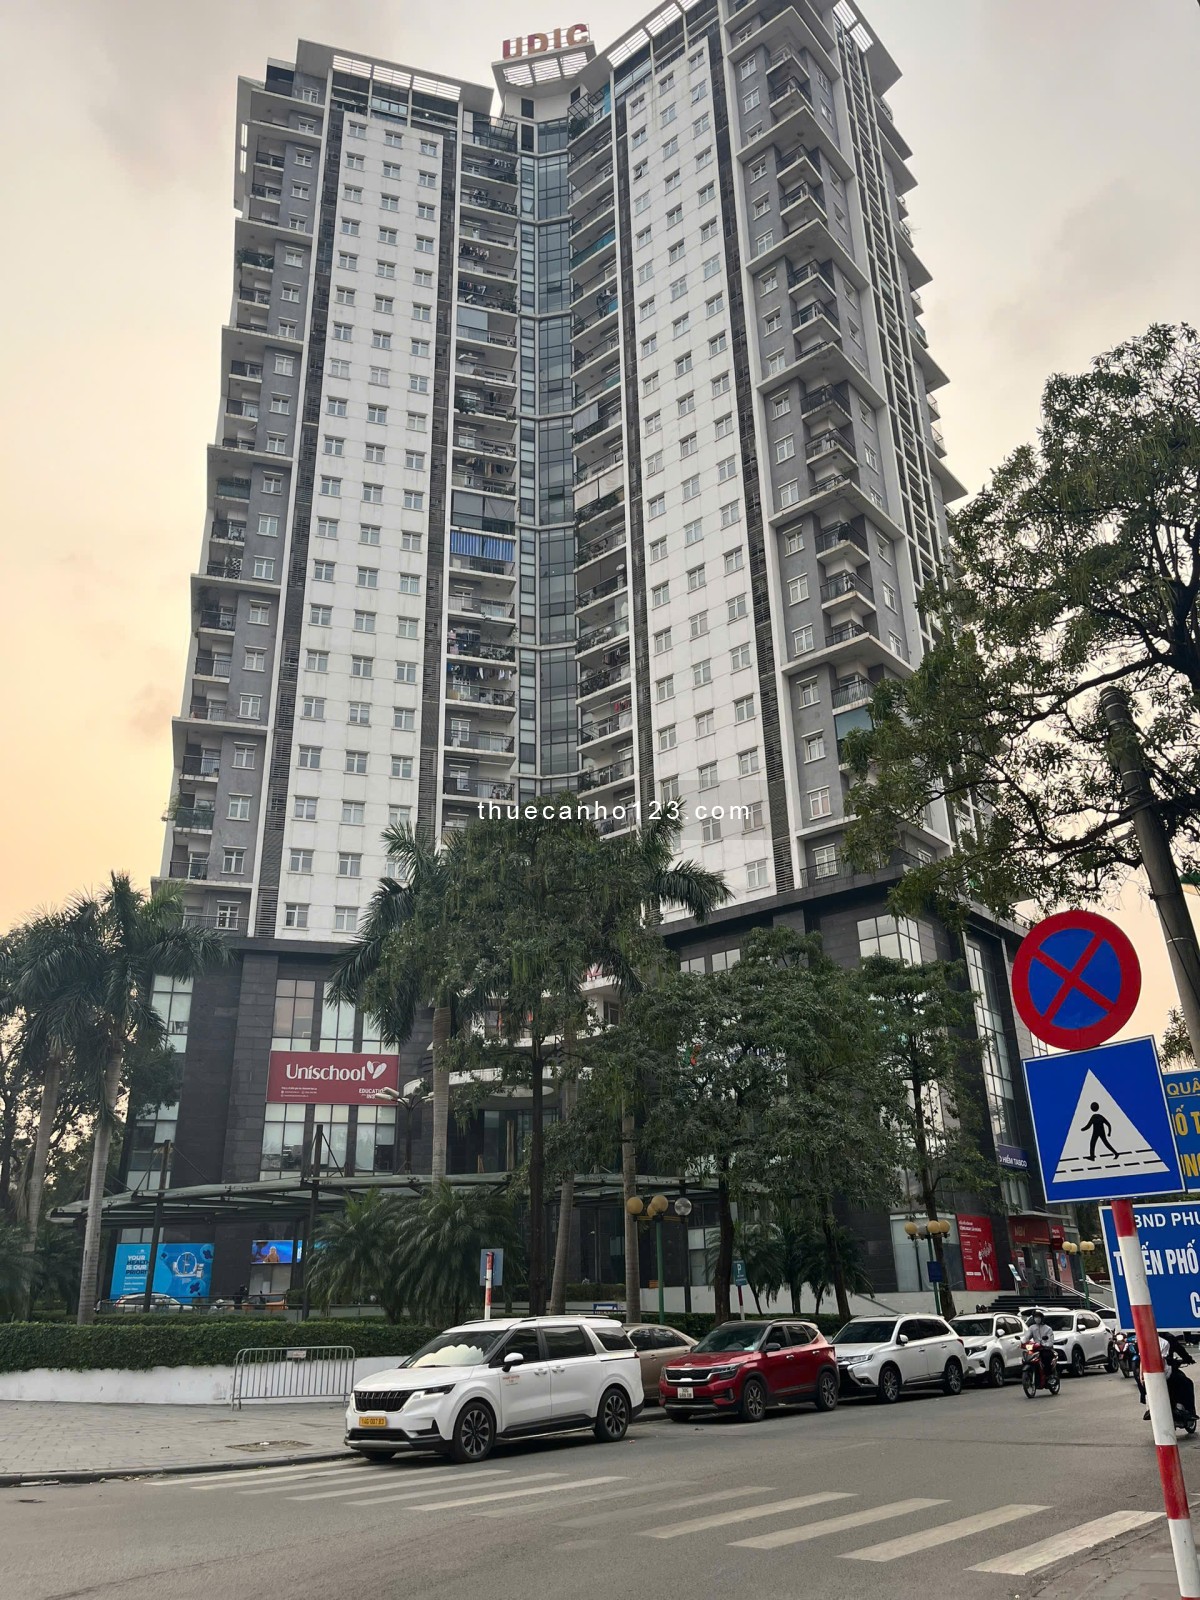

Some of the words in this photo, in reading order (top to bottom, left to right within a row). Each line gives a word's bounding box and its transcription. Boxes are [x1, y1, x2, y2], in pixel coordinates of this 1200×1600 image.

[502, 23, 588, 59] UDIC
[286, 1063, 366, 1081] Unischool
[1134, 1213, 1166, 1228] BND
[1165, 1239, 1199, 1275] PHỐ
